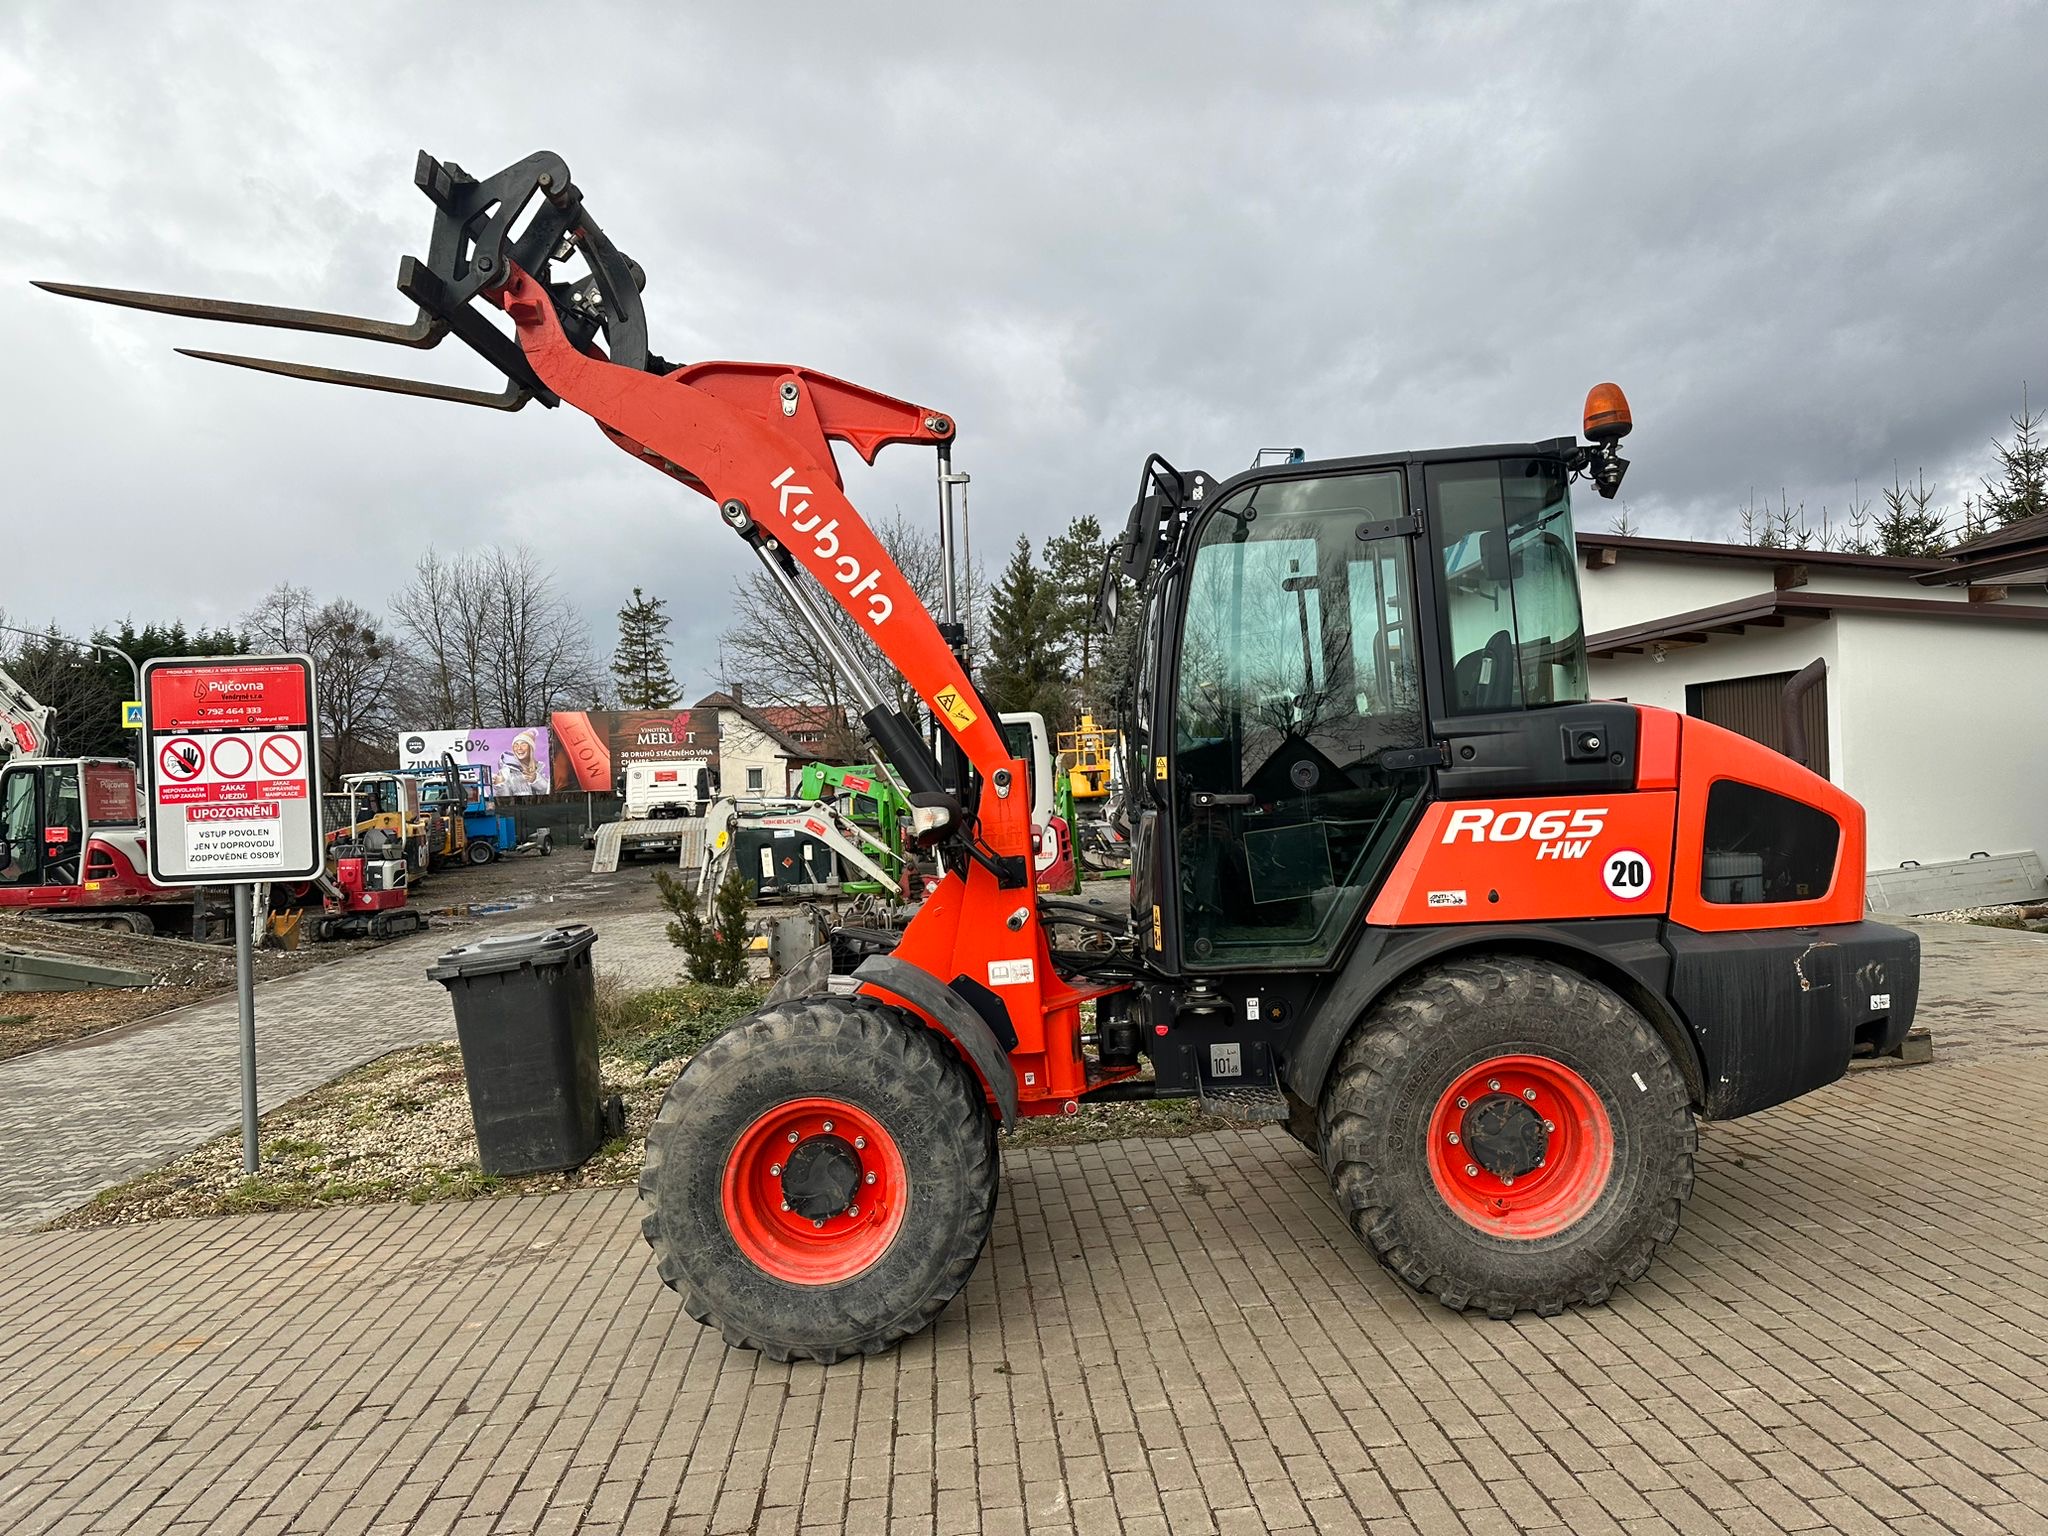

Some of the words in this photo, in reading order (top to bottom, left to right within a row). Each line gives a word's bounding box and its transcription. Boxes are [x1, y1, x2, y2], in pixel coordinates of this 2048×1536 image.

[770, 466, 893, 626] Kubota
[209, 680, 264, 693] Půjčovna
[246, 706, 262, 714] 333
[637, 732, 695, 745] MERLOT
[449, 740, 489, 752] -50%
[656, 749, 695, 757] STÁČENÉHO
[696, 748, 713, 756] VÍNA
[221, 783, 246, 791] ZÁKAZ
[192, 804, 273, 819] UPOZORNĚNÍ
[1441, 808, 1609, 844] RO65
[229, 829, 269, 837] POVOLEN
[194, 842, 210, 850] JEN
[220, 841, 275, 849] DOPROVODU
[1536, 840, 1592, 860] HW
[250, 851, 280, 860] OSOBY
[1611, 860, 1644, 887] 20
[1214, 1058, 1231, 1075] 101
